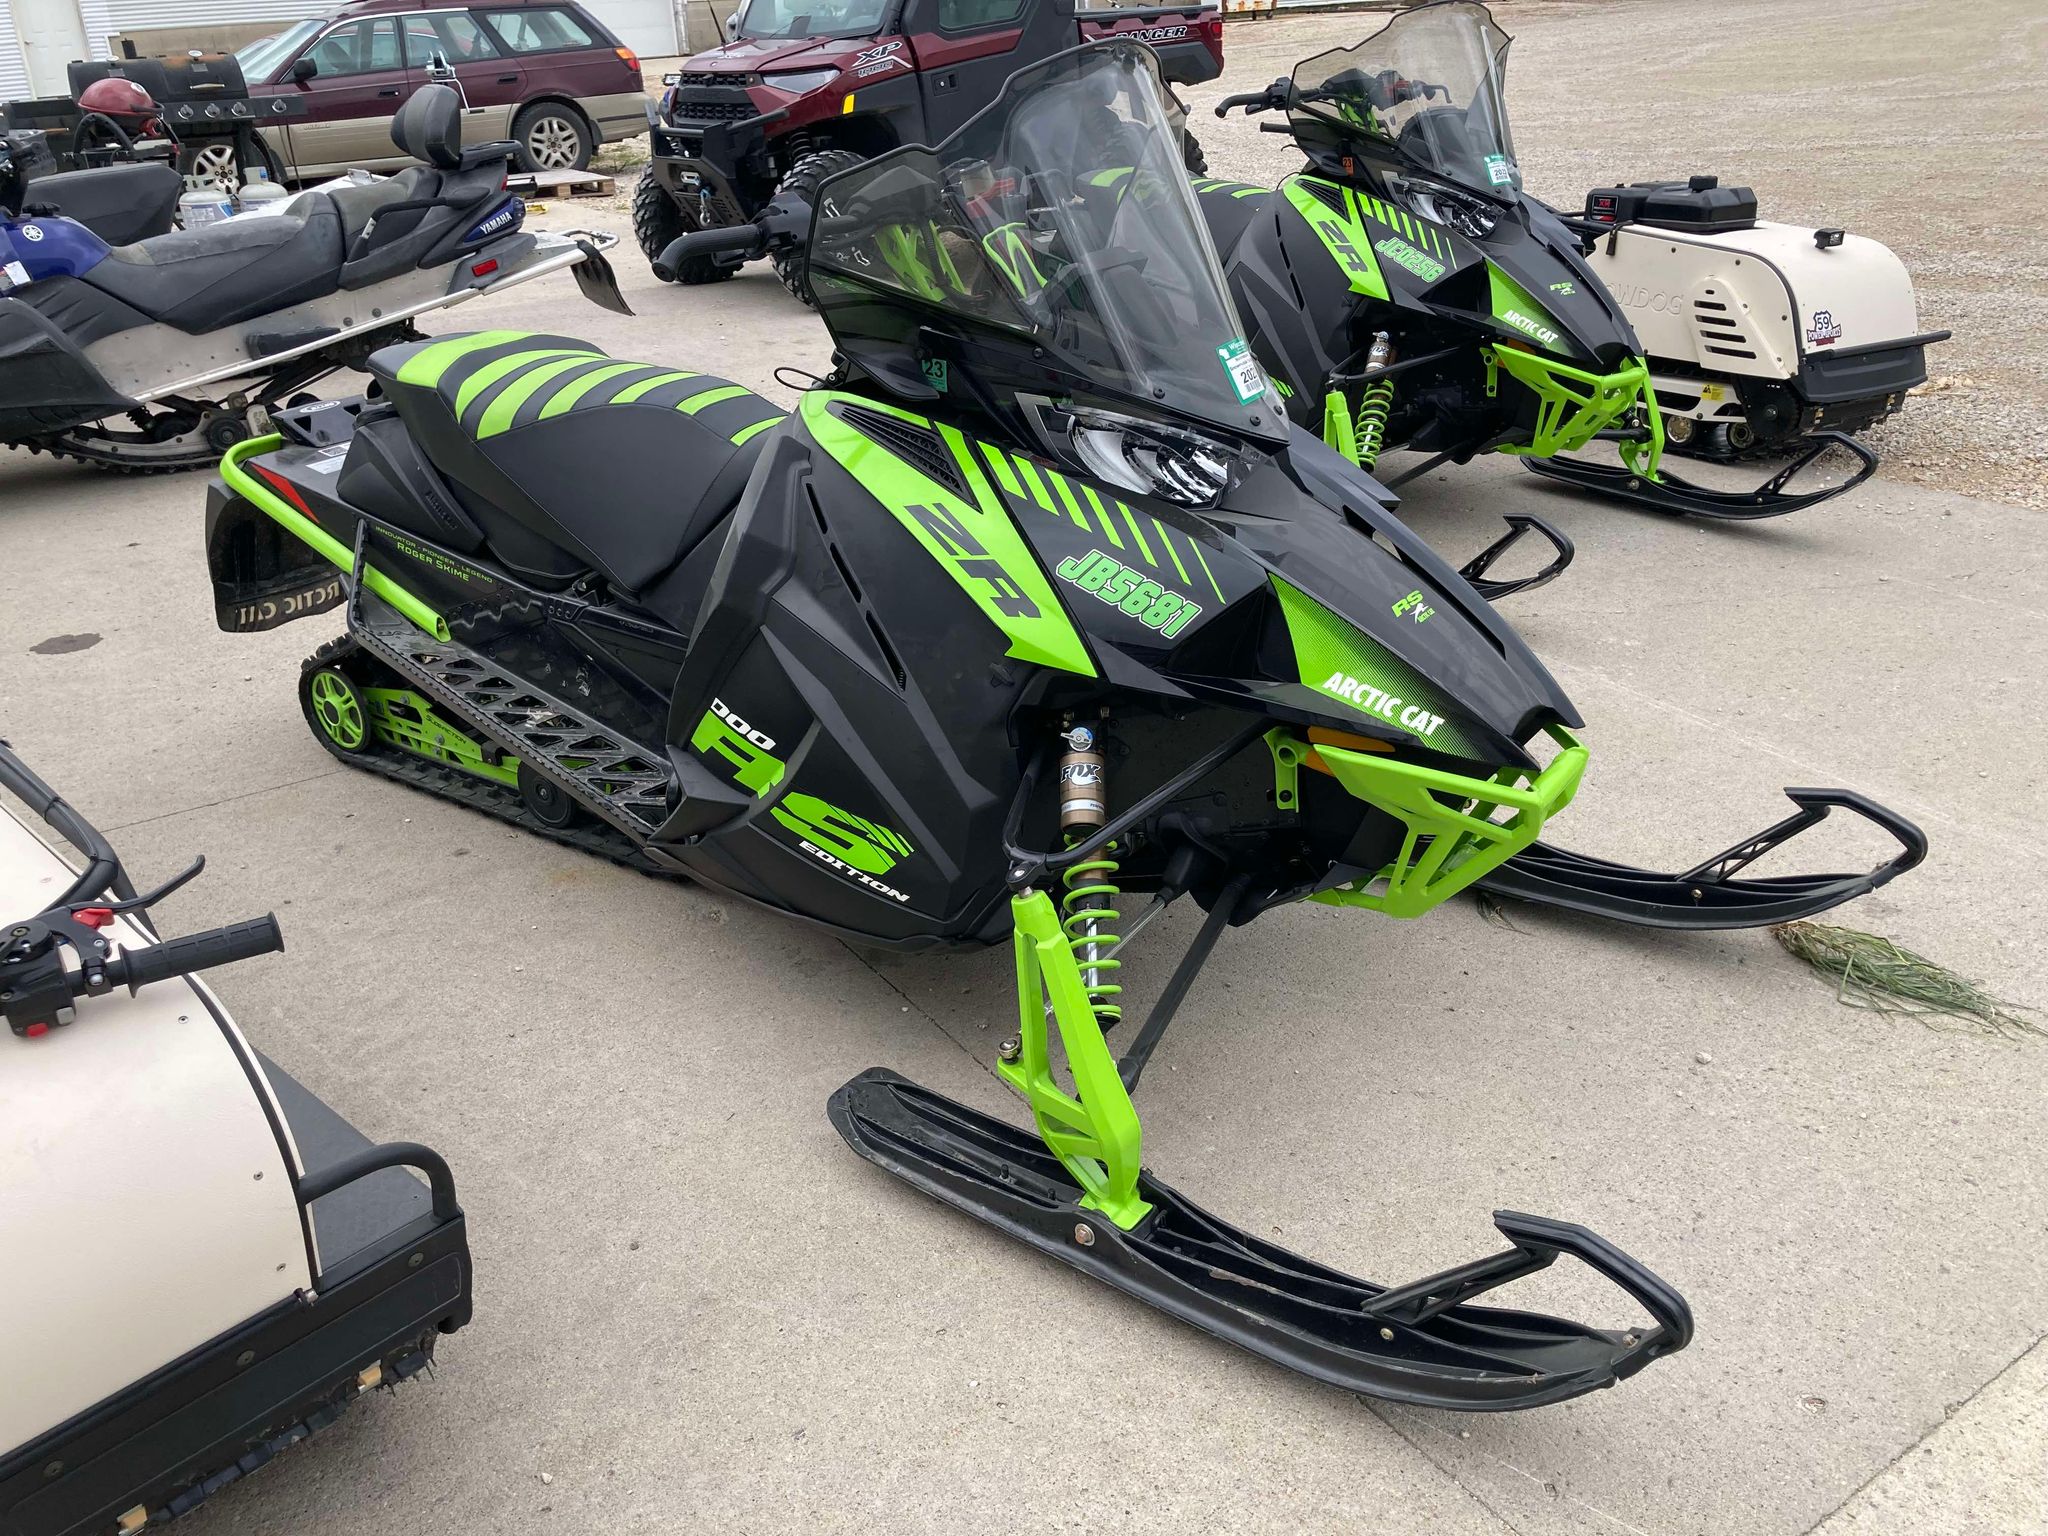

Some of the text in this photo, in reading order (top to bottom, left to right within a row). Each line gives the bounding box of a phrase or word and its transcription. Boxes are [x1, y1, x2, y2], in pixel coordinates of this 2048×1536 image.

[852, 41, 902, 67] XP
[480, 211, 512, 234] YAMAHA
[1316, 219, 1369, 272] ZR
[1503, 309, 1559, 343] ARCTIC CAT
[1817, 316, 1830, 330] 59
[925, 360, 944, 378] 23
[375, 525, 493, 584] INNOVATOR PIONEER LEGEND
[397, 541, 470, 582] ROGER SKIME
[904, 502, 1042, 618] ZR
[1056, 548, 1202, 639] JB5681
[1391, 590, 1423, 618] RS
[1322, 671, 1445, 736] ARCTIC CAT
[1061, 763, 1102, 784] FOX
[799, 840, 910, 902] EDITION
